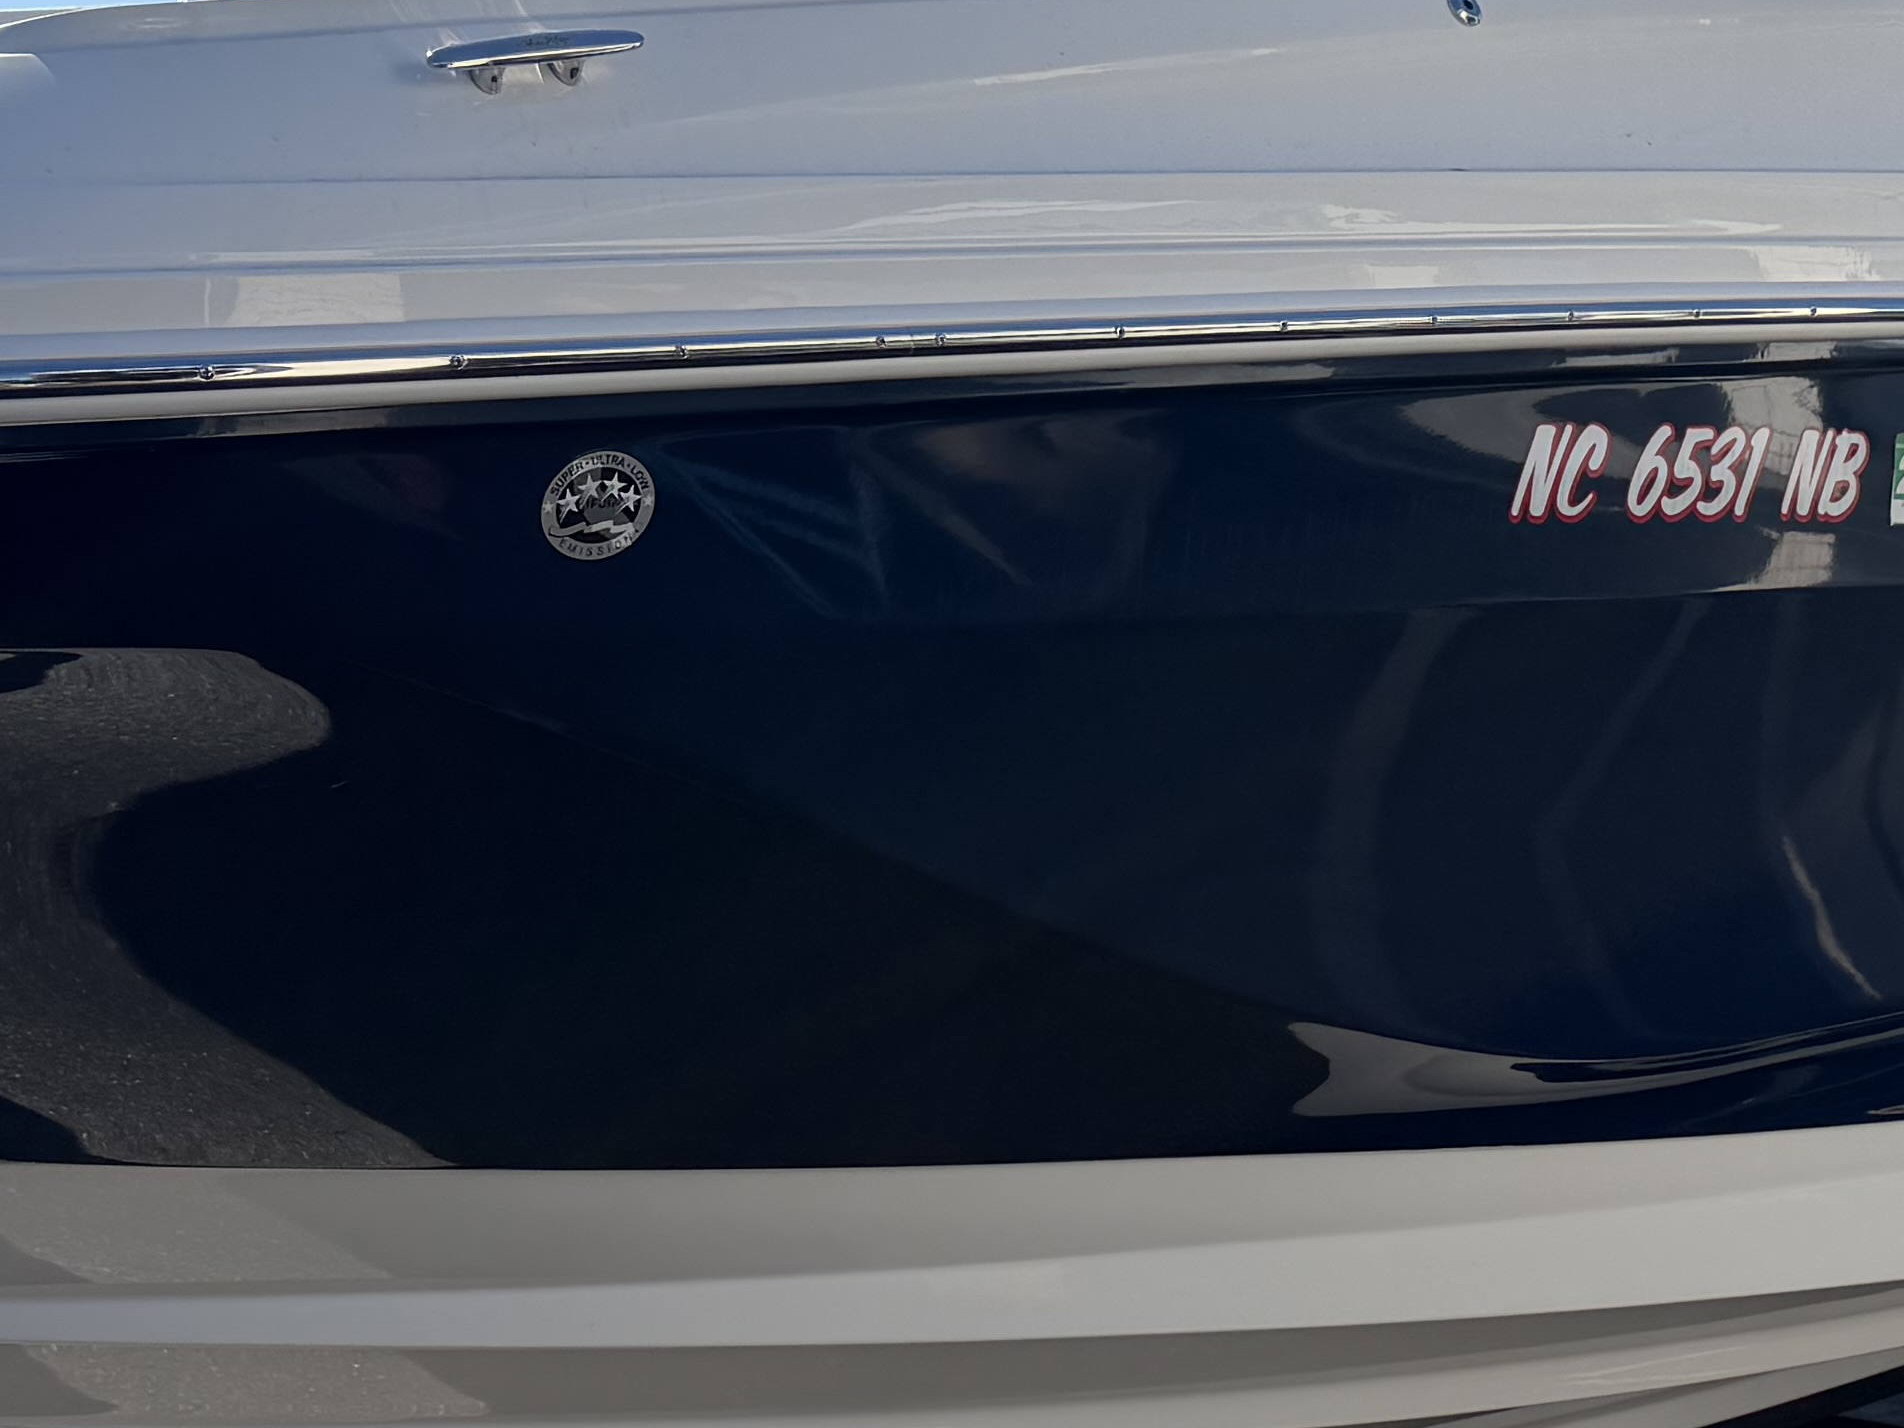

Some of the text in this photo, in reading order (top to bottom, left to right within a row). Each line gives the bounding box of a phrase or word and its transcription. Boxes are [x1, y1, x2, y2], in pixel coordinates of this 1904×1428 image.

[1509, 422, 1870, 523] NC 6531 NB
